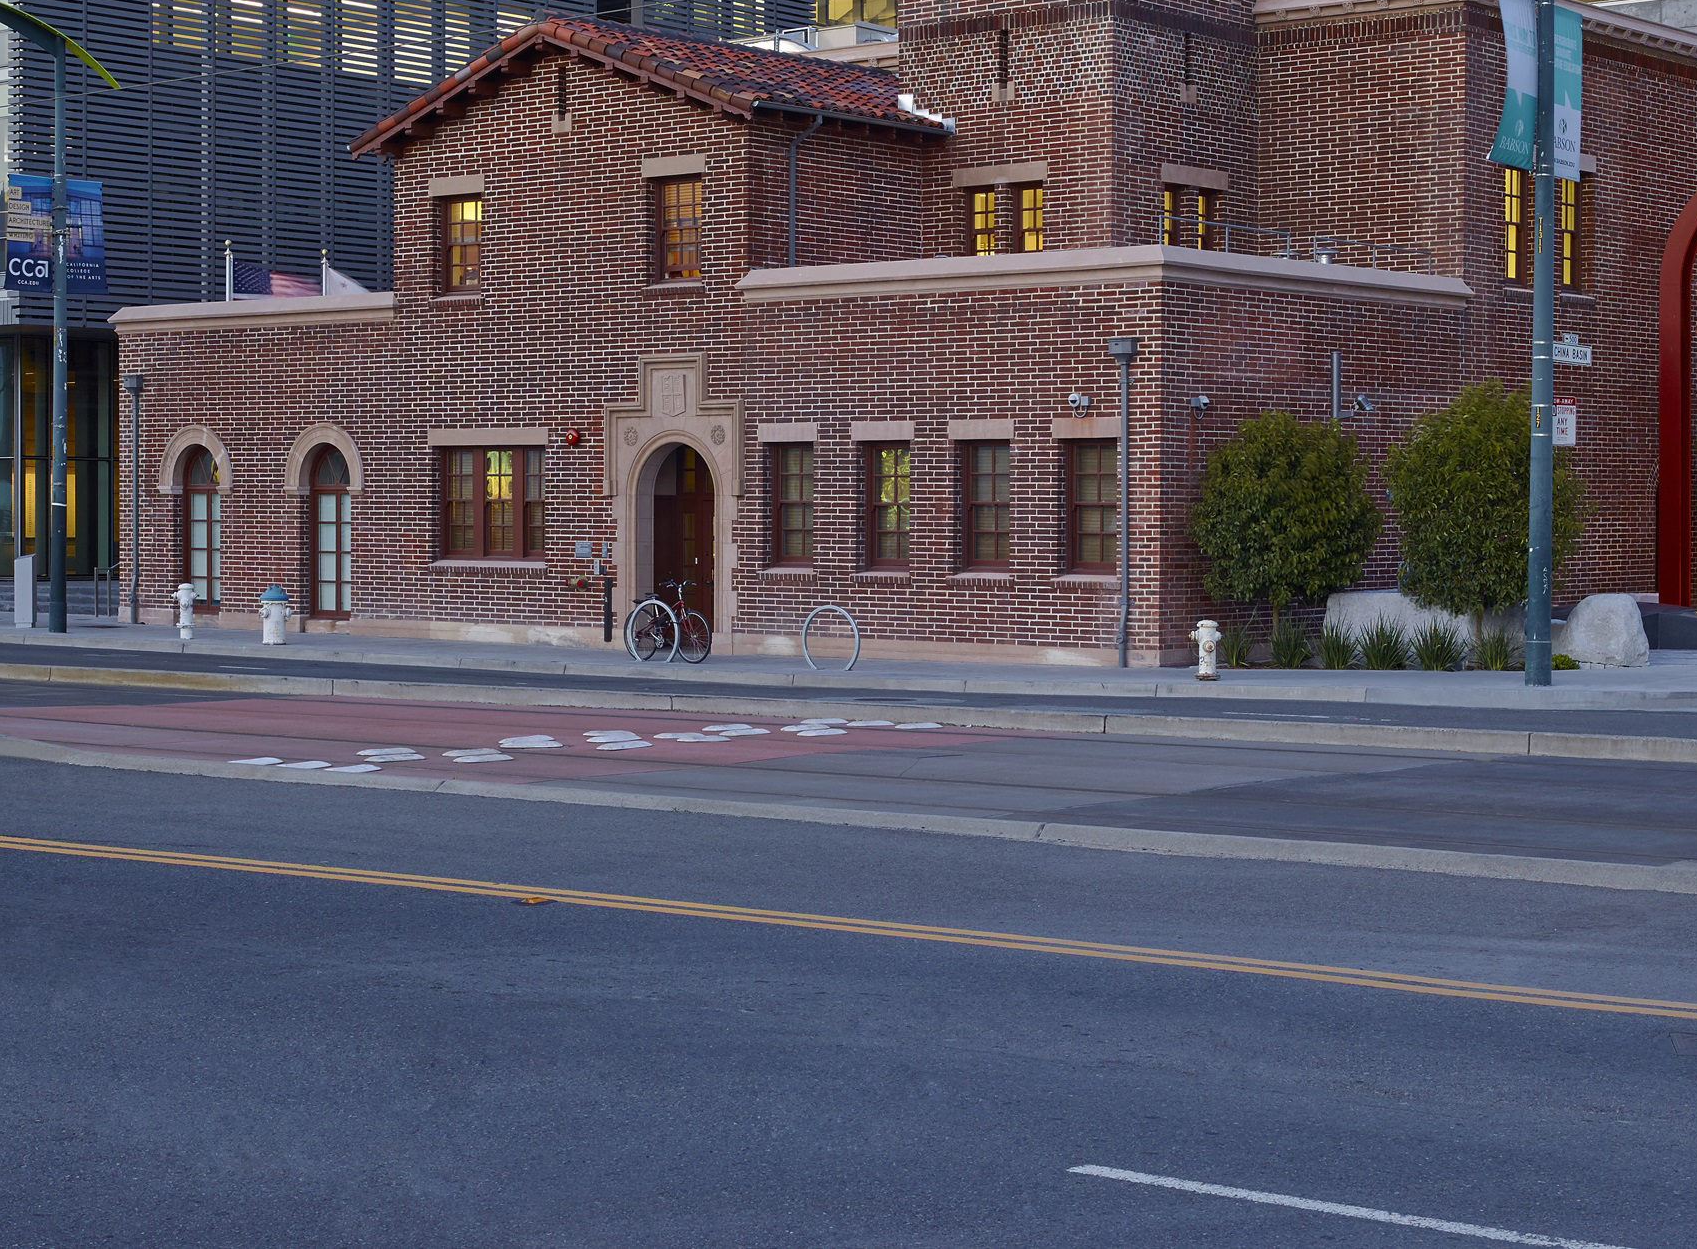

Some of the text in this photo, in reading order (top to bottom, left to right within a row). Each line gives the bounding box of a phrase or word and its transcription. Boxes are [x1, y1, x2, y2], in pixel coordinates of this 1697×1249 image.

[1499, 135, 1530, 155] BABSON
[1554, 136, 1576, 152] ABSON
[8, 202, 30, 211] DESIGN
[8, 216, 50, 227] ARCHITECTURE
[1554, 346, 1588, 361] CHINA BASIN
[1557, 406, 1575, 415] STOPPING
[1557, 417, 1568, 426] ANY
[1556, 427, 1568, 436] TIME
